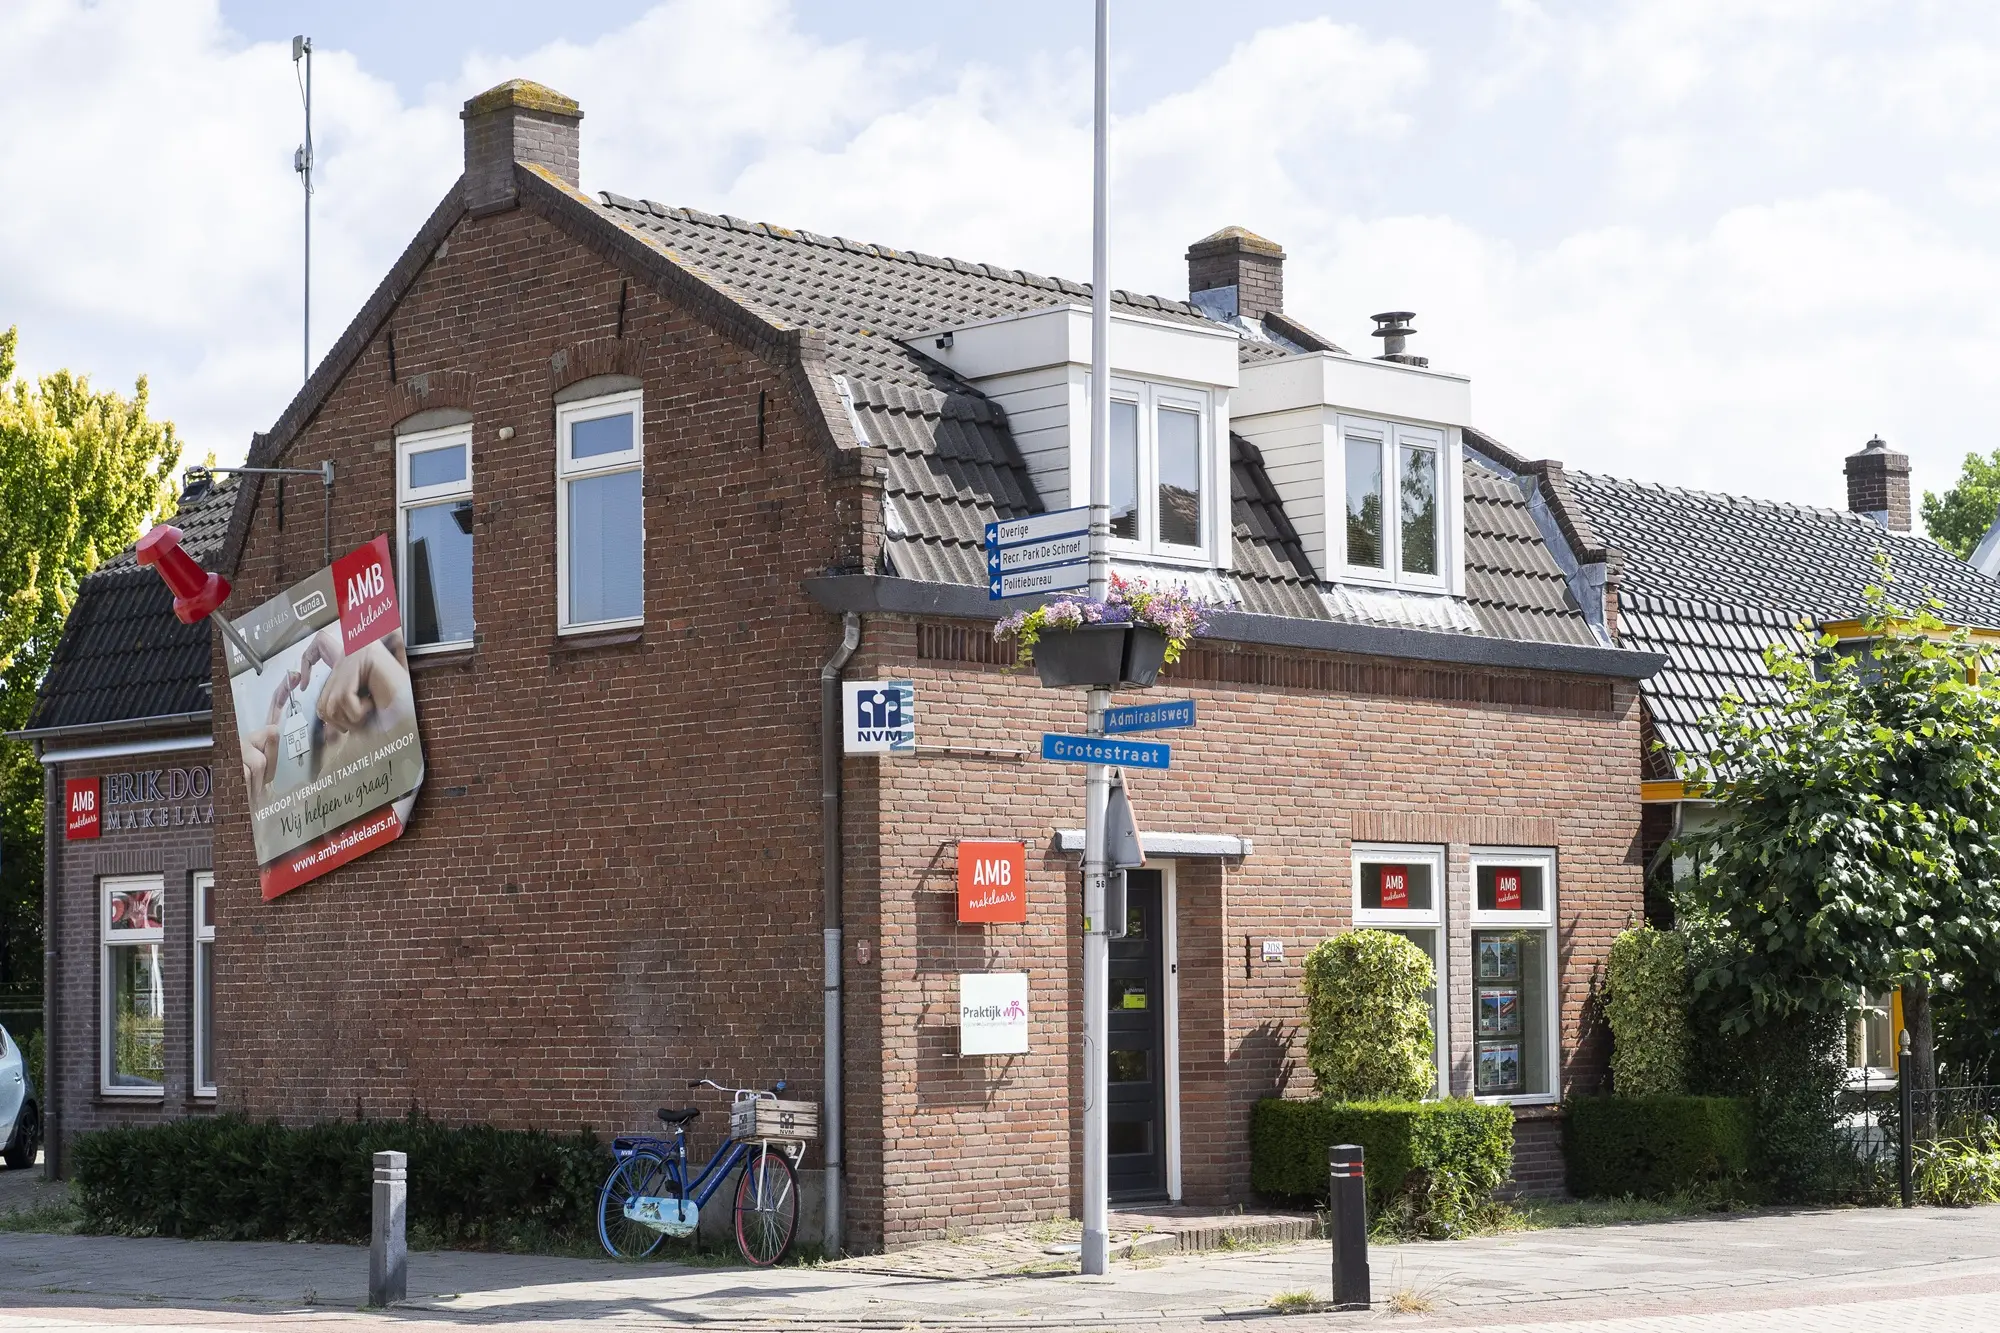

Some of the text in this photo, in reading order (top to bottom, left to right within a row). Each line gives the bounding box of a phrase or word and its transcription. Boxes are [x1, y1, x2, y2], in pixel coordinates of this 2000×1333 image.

[1000, 525, 1029, 538] Overige
[1003, 541, 1081, 565] Recr. Park De Schroef
[347, 562, 385, 612] AMB
[1004, 575, 1052, 590] Politiebureau
[299, 596, 321, 615] funda
[348, 596, 393, 641] makelaars
[1110, 707, 1189, 727] Admiraalsweg
[857, 730, 902, 742] NVM
[1054, 740, 1159, 763] Grotestraat
[106, 765, 214, 805] ERIK DO
[255, 732, 414, 822] VERKOOP VERHUUR TAXATIE AANKOOP
[72, 790, 95, 812] AMB
[280, 760, 393, 839] Wij helpen u graag!
[69, 814, 97, 830] makelaars
[293, 811, 397, 873] www.amb-makelaars.nl
[973, 859, 1011, 886] AMB
[1385, 875, 1404, 890] AMB
[1500, 877, 1517, 891] AMB
[969, 889, 1016, 909] makelaars
[963, 1005, 1002, 1020] Praktijk
